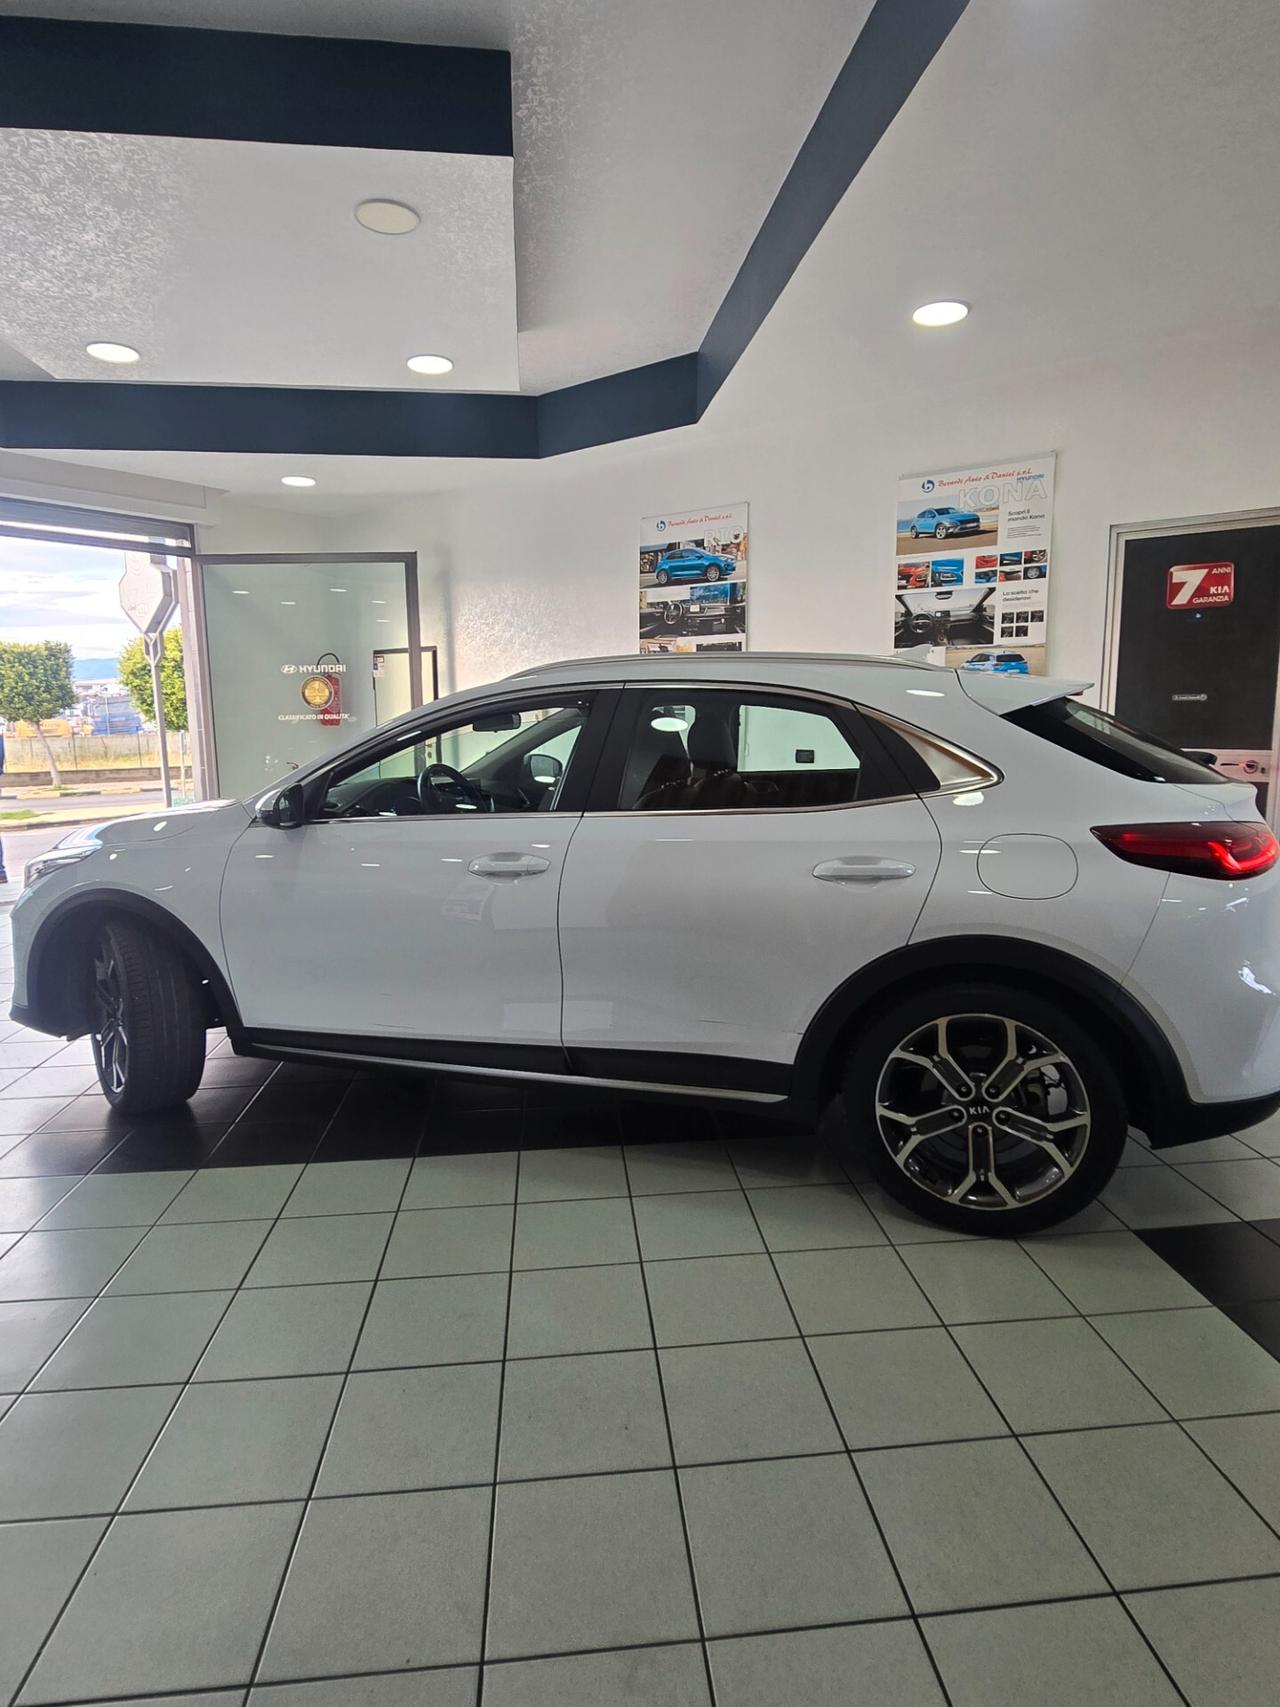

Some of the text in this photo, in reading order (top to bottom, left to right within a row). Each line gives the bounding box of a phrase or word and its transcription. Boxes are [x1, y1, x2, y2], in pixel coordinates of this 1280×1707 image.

[960, 480, 1048, 509] KONA
[1171, 568, 1209, 605] 7
[1209, 585, 1230, 594] KIA
[1192, 595, 1229, 604] GARANZIA
[299, 664, 346, 673] HYUNDAI
[968, 1105, 990, 1115] KIA
